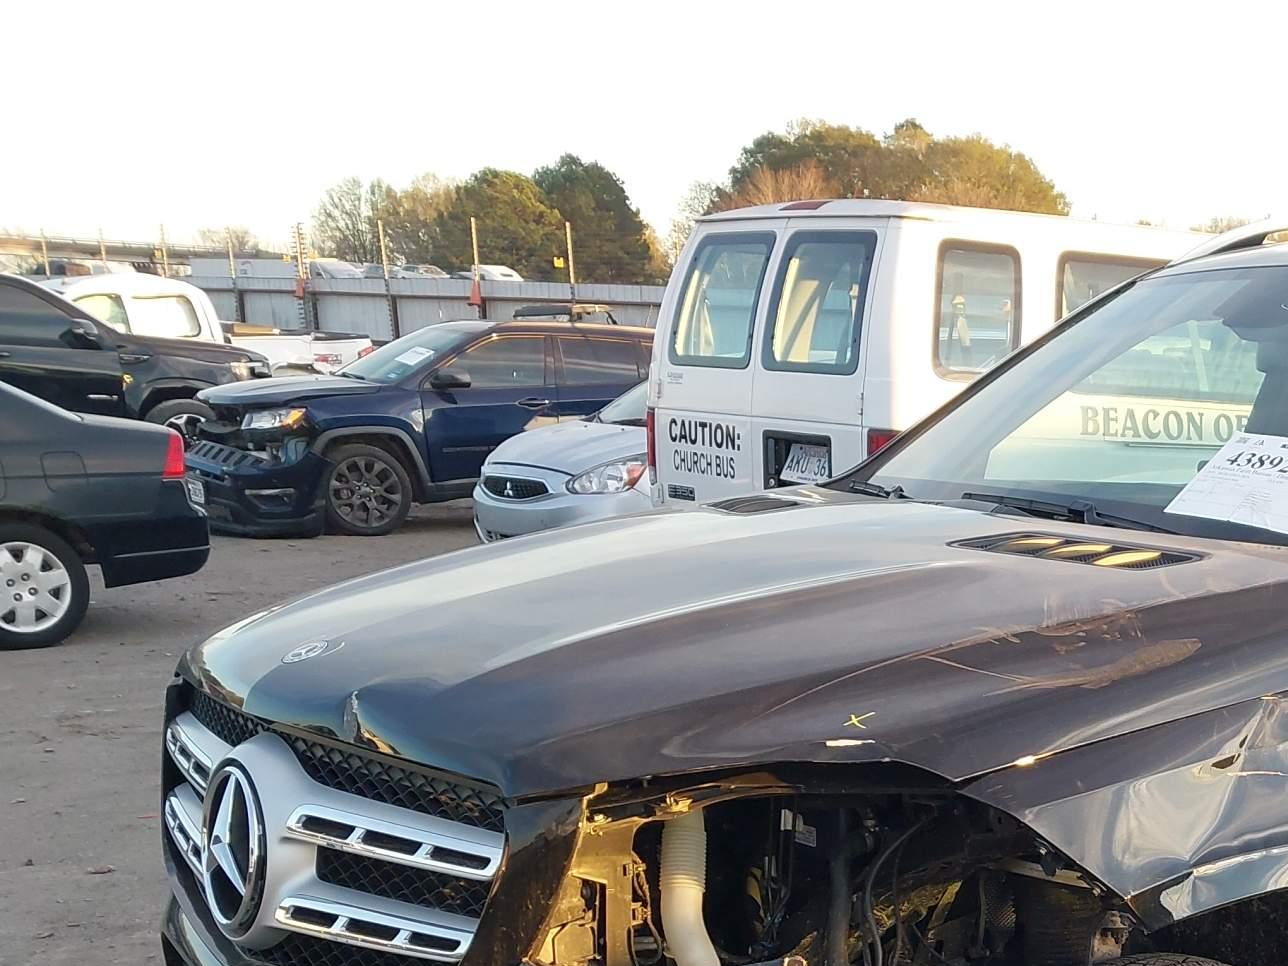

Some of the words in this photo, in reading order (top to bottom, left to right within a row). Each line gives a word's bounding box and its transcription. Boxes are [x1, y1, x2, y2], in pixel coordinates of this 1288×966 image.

[669, 418, 741, 451] CAUTION:
[1080, 406, 1204, 442] BEACON
[673, 449, 713, 476] CHURCH
[715, 455, 736, 479] BUS
